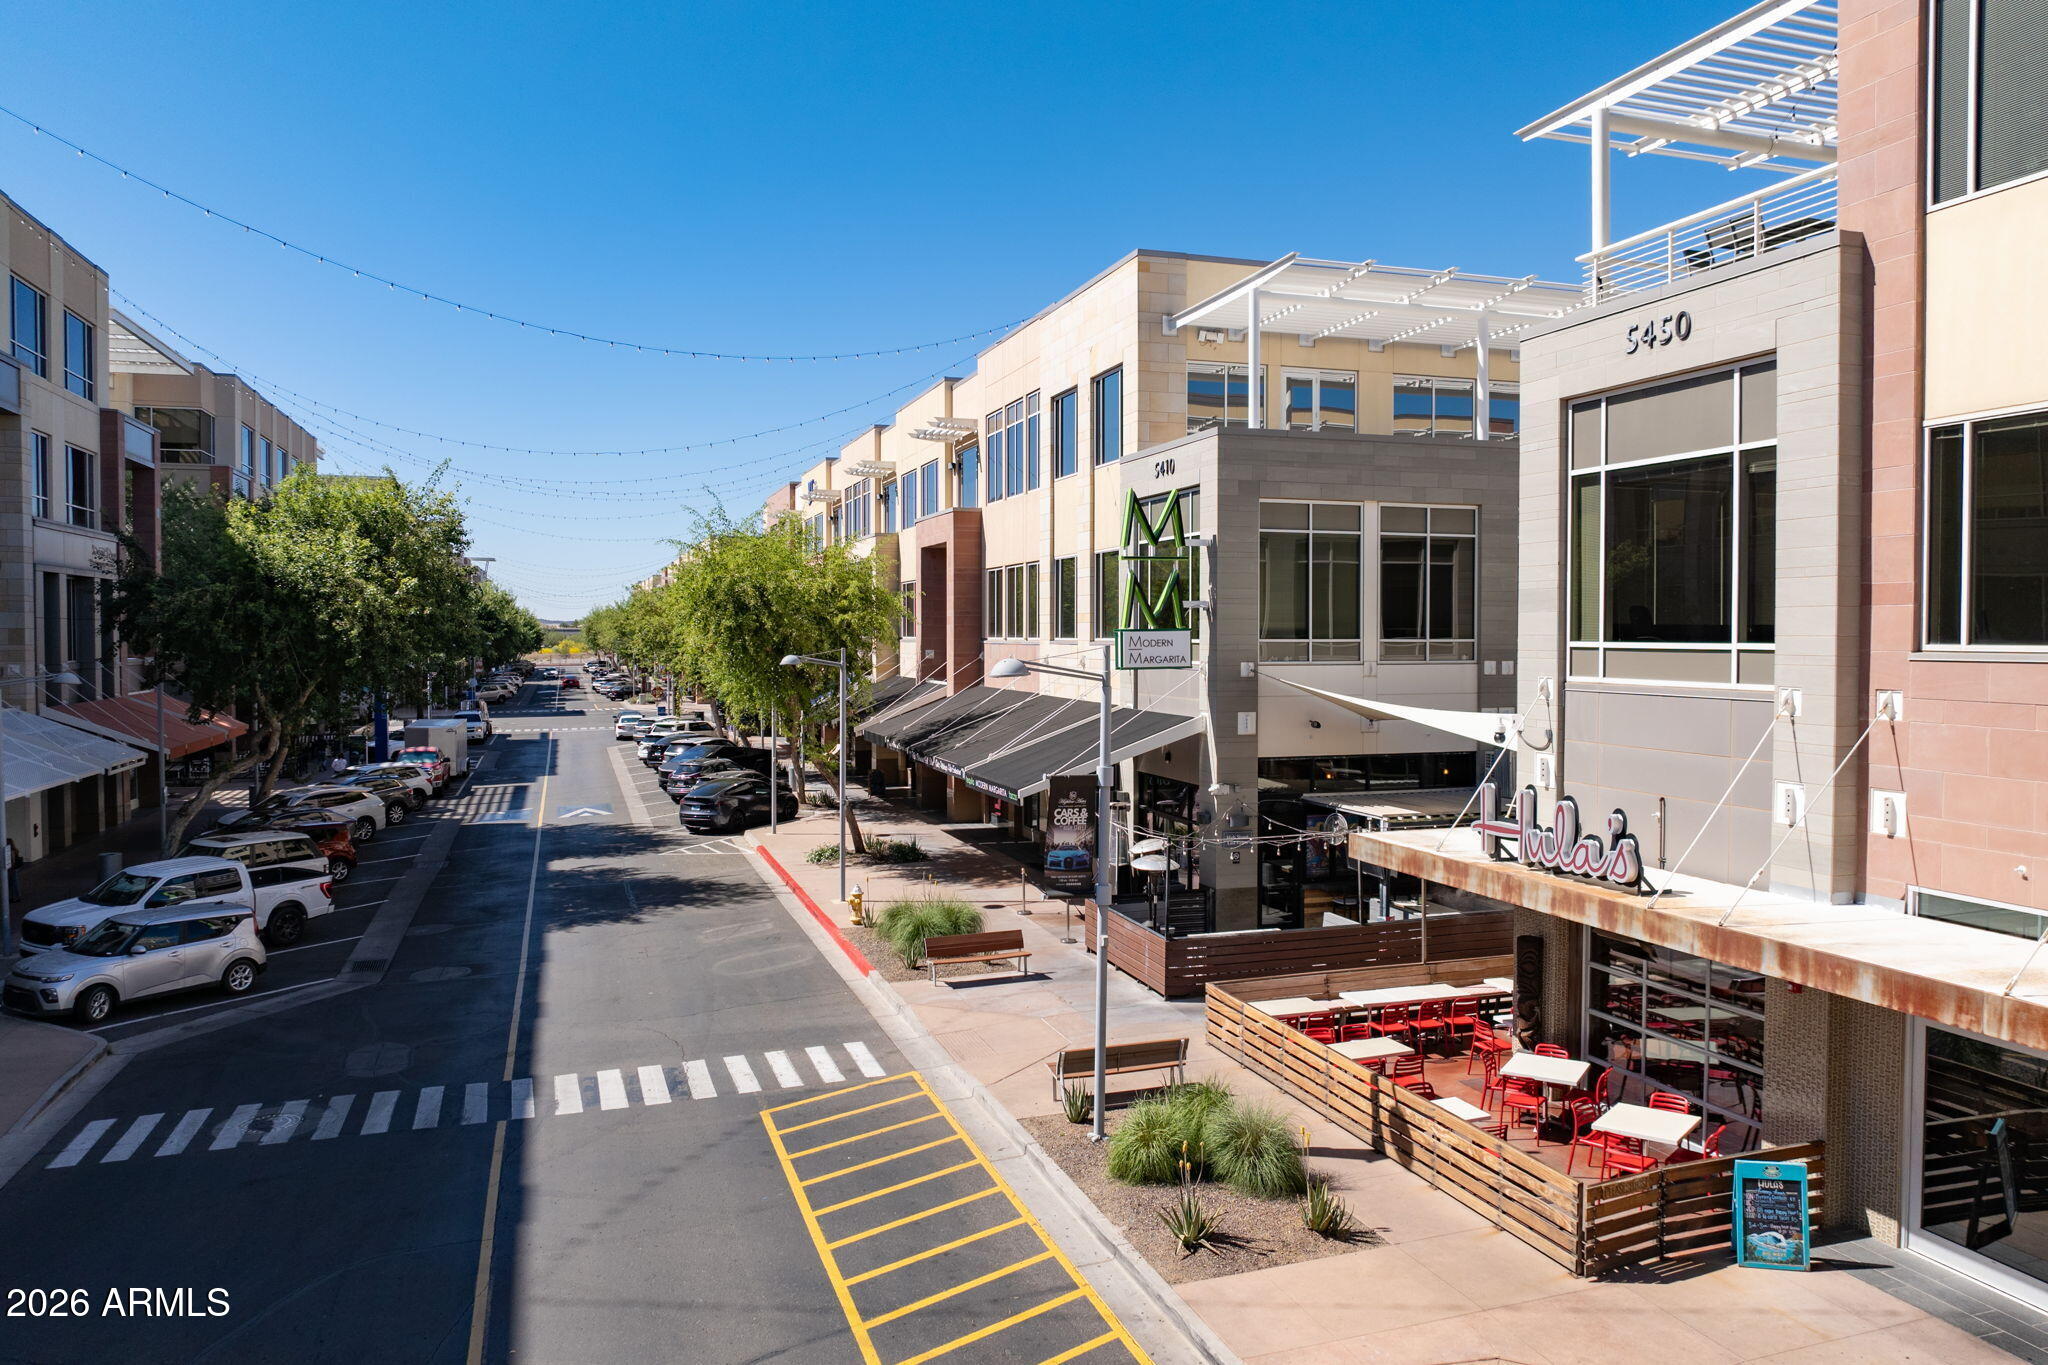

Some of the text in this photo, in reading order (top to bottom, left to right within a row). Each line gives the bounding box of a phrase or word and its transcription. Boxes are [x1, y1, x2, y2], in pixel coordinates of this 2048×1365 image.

[1626, 310, 1692, 355] 5450
[1155, 458, 1176, 479] 5410
[1053, 808, 1088, 818] CARS &
[1053, 816, 1087, 826] COFFEE
[1471, 782, 1642, 887] Hula's
